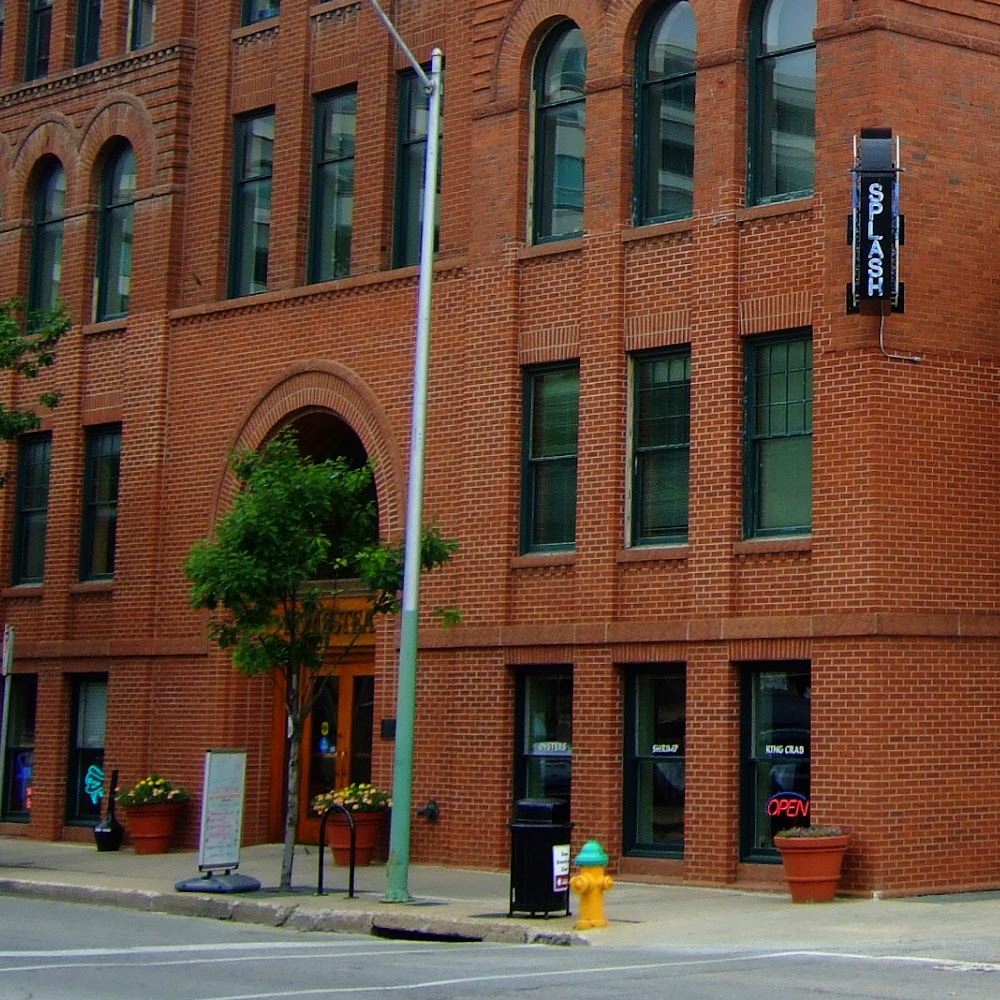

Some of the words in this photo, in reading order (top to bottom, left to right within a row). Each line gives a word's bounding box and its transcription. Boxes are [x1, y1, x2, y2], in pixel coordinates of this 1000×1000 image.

[867, 182, 885, 297] SPLASH
[538, 741, 568, 752] OYSTERS
[652, 744, 680, 753] SHRIMP
[765, 744, 784, 755] KING
[784, 744, 805, 755] CRAB
[767, 798, 810, 818] OPEN
